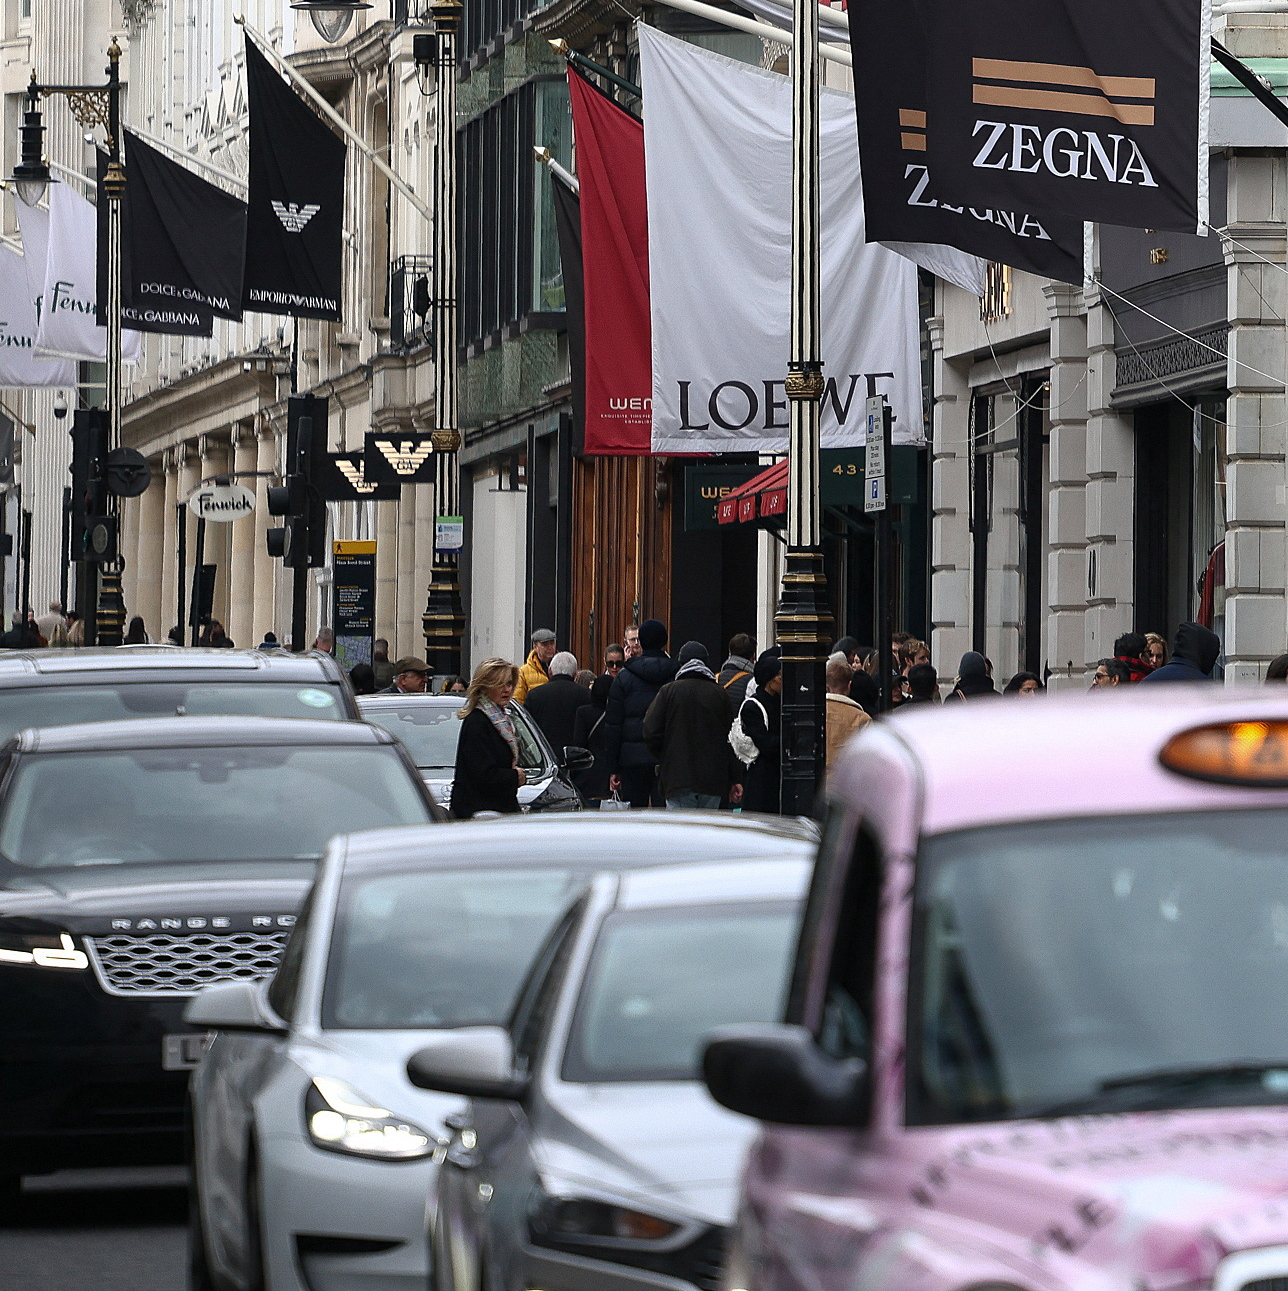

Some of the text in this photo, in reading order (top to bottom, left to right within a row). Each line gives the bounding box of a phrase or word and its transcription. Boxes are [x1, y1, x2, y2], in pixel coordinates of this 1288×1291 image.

[972, 119, 1159, 188] ZEGNA
[249, 288, 337, 311] EMPORIO ARMANI
[199, 493, 252, 515] Fenwick
[111, 916, 232, 931] RANGE
